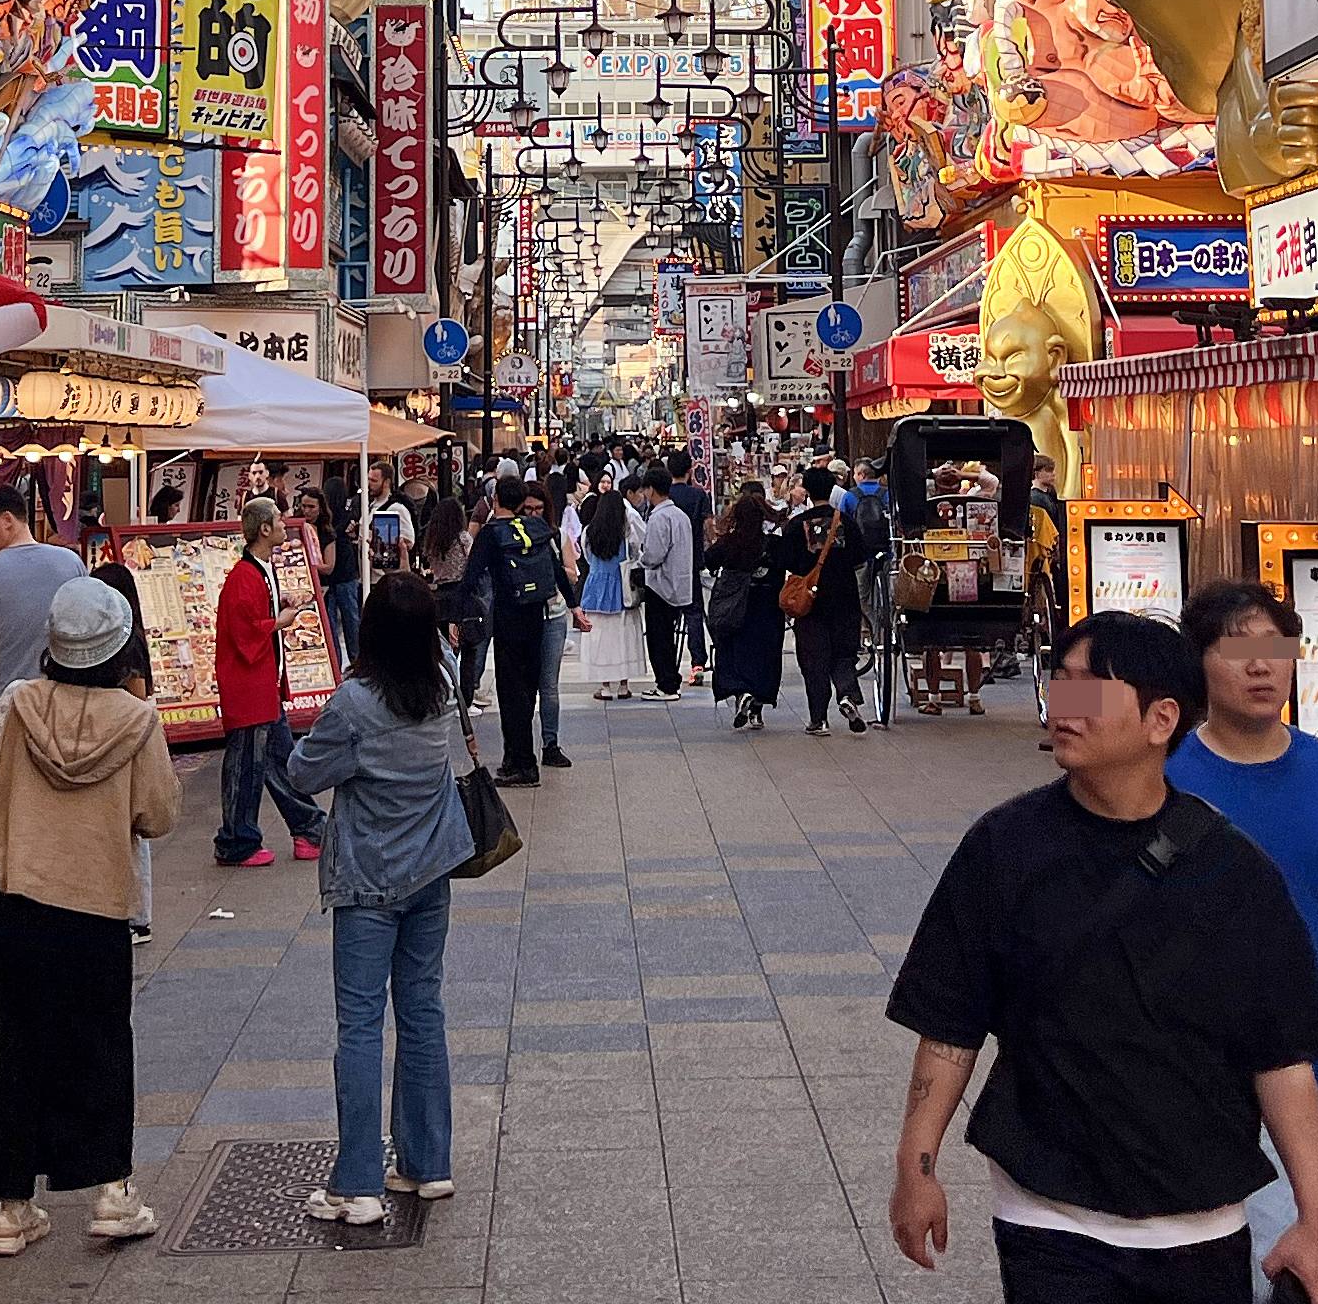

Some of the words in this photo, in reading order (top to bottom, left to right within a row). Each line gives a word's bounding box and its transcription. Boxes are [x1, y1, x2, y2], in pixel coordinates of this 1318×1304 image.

[600, 53, 743, 75] EXPO205
[92, 84, 159, 125] 天閣店
[191, 105, 269, 133] チャンピオン
[291, 84, 321, 252] てっちり
[380, 55, 420, 287] 珍味てっちり
[1138, 242, 1248, 274] 日本一の串か
[432, 369, 459, 380] 9-22
